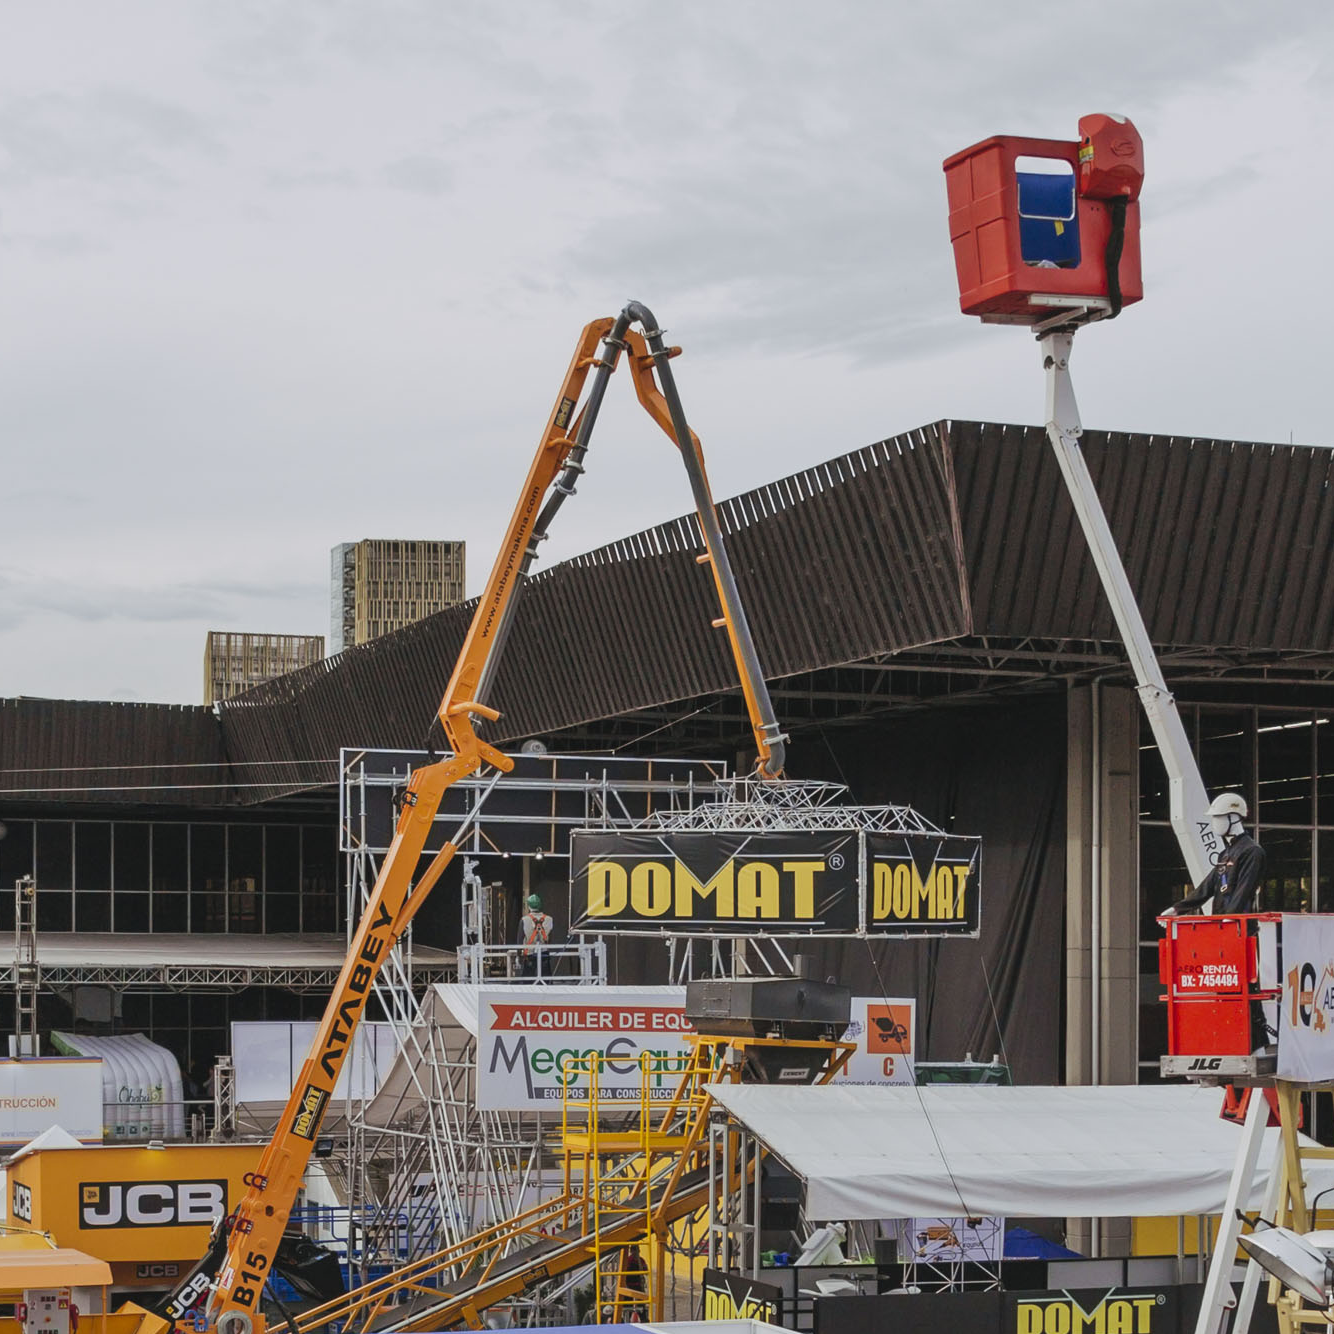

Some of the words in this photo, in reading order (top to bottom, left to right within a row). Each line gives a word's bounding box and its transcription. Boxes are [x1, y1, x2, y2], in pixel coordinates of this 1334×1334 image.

[587, 859, 826, 918] DOMAT
[873, 861, 970, 920] DOMAT
[321, 910, 397, 1081] ATABEY
[511, 1010, 612, 1030] ALQUILER
[619, 1013, 646, 1030] DE
[1187, 1058, 1222, 1070] JLG
[544, 1088, 585, 1099] EQUPOS
[13, 1183, 32, 1221] JCB
[83, 1183, 224, 1226] JCB
[138, 1264, 179, 1277] JCB
[234, 1252, 268, 1308] B15
[170, 1272, 211, 1319] JCB
